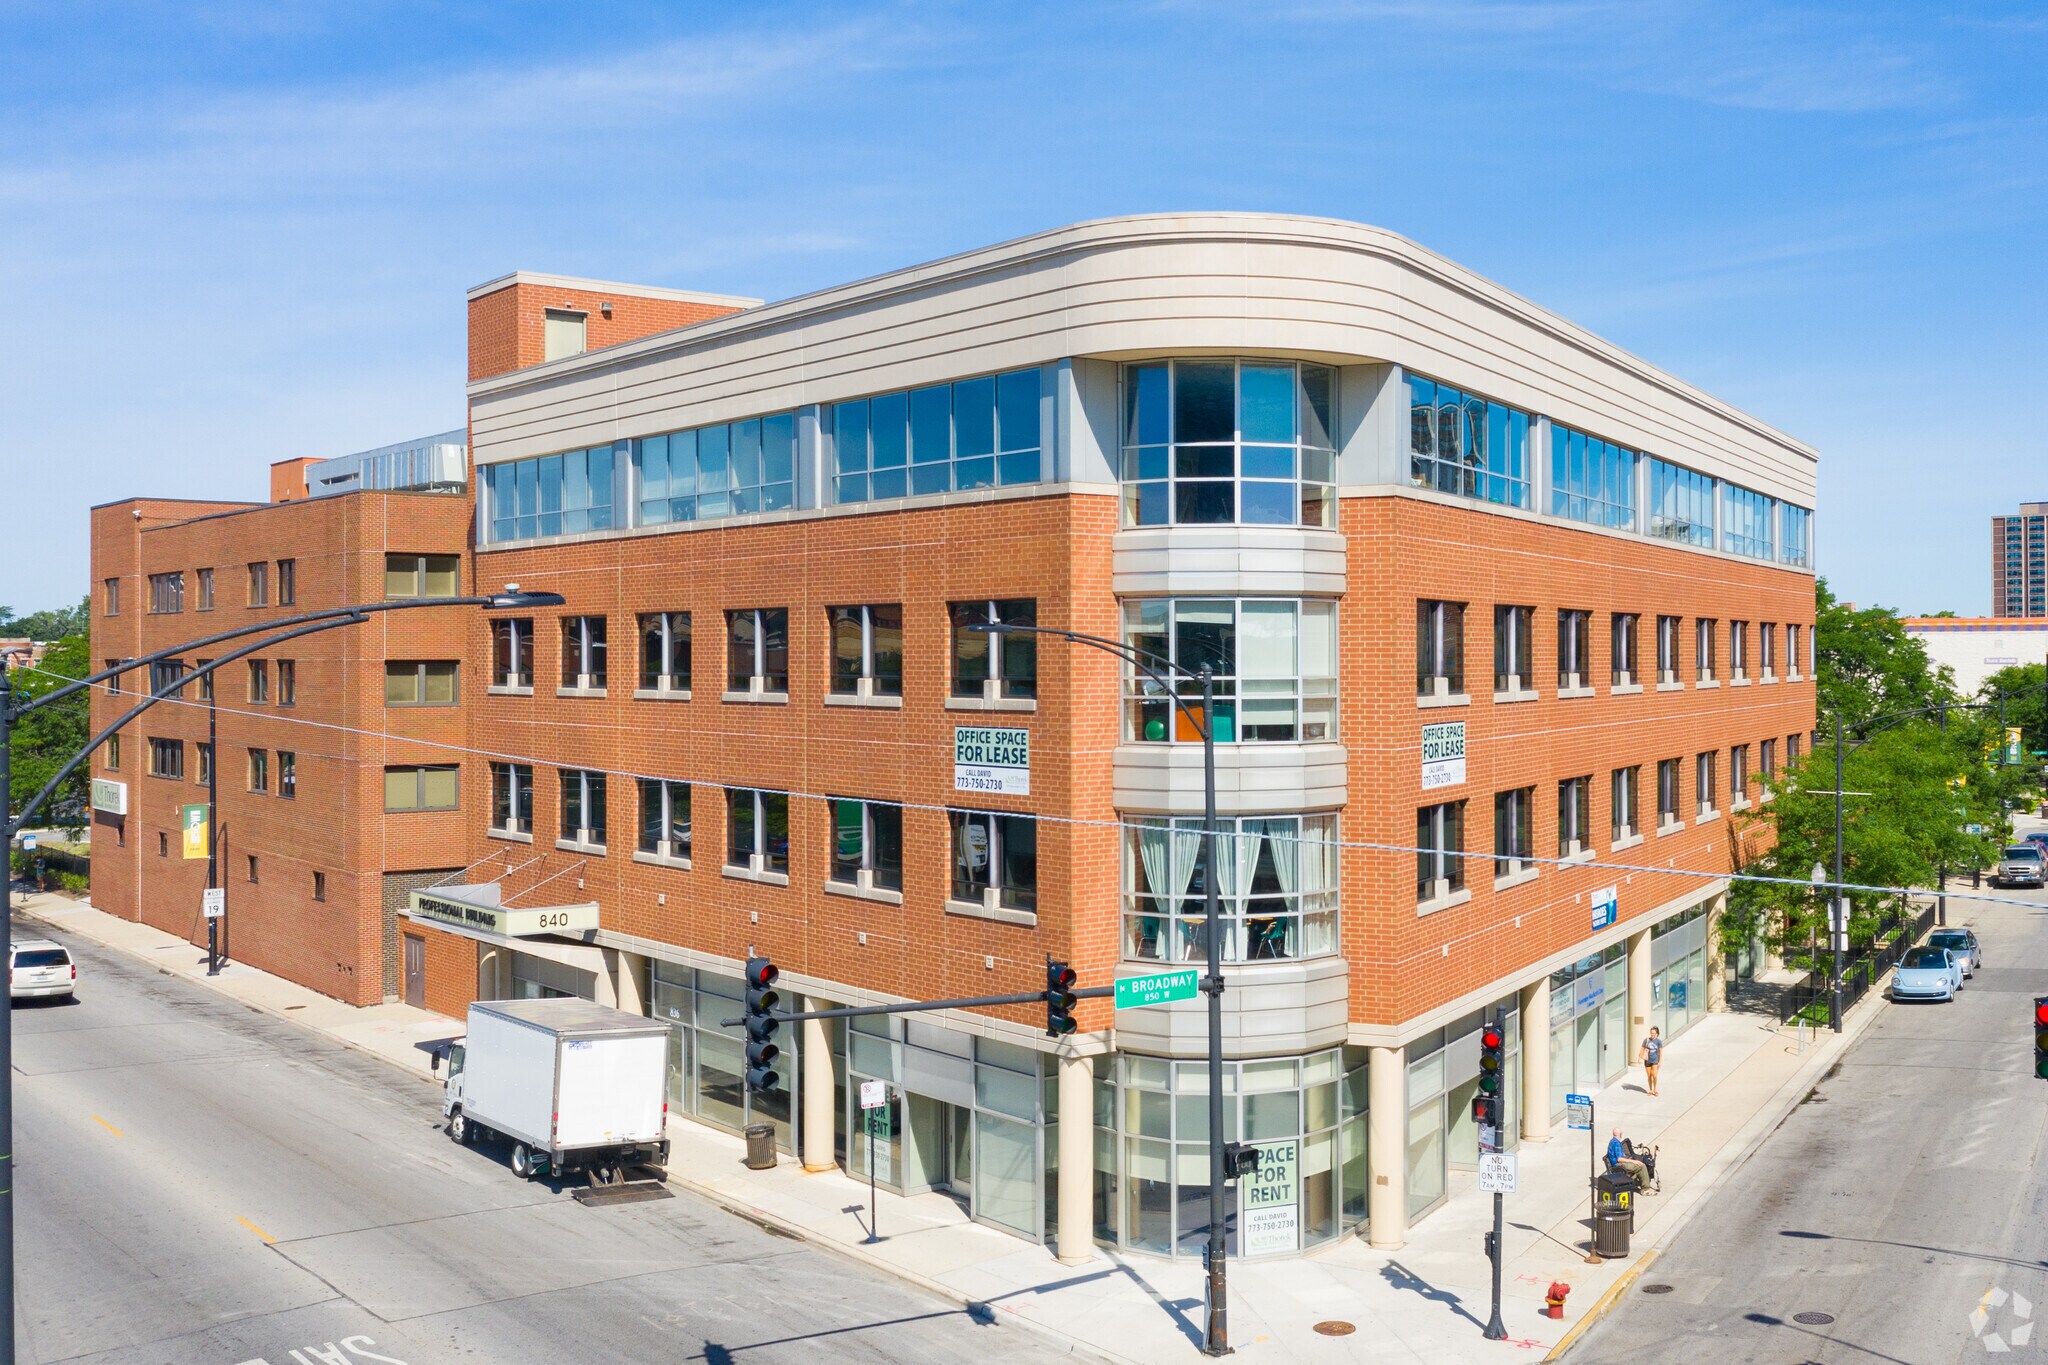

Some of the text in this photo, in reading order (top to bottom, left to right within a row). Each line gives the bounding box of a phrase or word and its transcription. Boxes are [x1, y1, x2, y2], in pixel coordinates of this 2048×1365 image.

[957, 730, 1027, 746] OFFICE SPACE
[1423, 725, 1464, 741] OFFICE SPACE
[957, 745, 1027, 765] FOR LEASE
[1423, 740, 1464, 760] FOR LEASE
[965, 769, 992, 778] CALL DAVID
[957, 777, 1003, 790] 773-750-2730
[209, 905, 219, 913] 19
[418, 897, 496, 926] PROFESSIONAL BUILDING
[539, 913, 569, 928] 840
[1132, 974, 1194, 993] BROADWAY
[1144, 990, 1170, 1002] 850 W
[1258, 1146, 1294, 1164] PACE
[1492, 1156, 1503, 1164] NO
[1255, 1166, 1286, 1184] FOR
[1481, 1172, 1514, 1181] ON RED
[1487, 1165, 1508, 1173] TURN
[1250, 1184, 1291, 1203] RENT
[1269, 1212, 1288, 1220] DAVID
[1248, 1219, 1294, 1232] 773-750-2730
